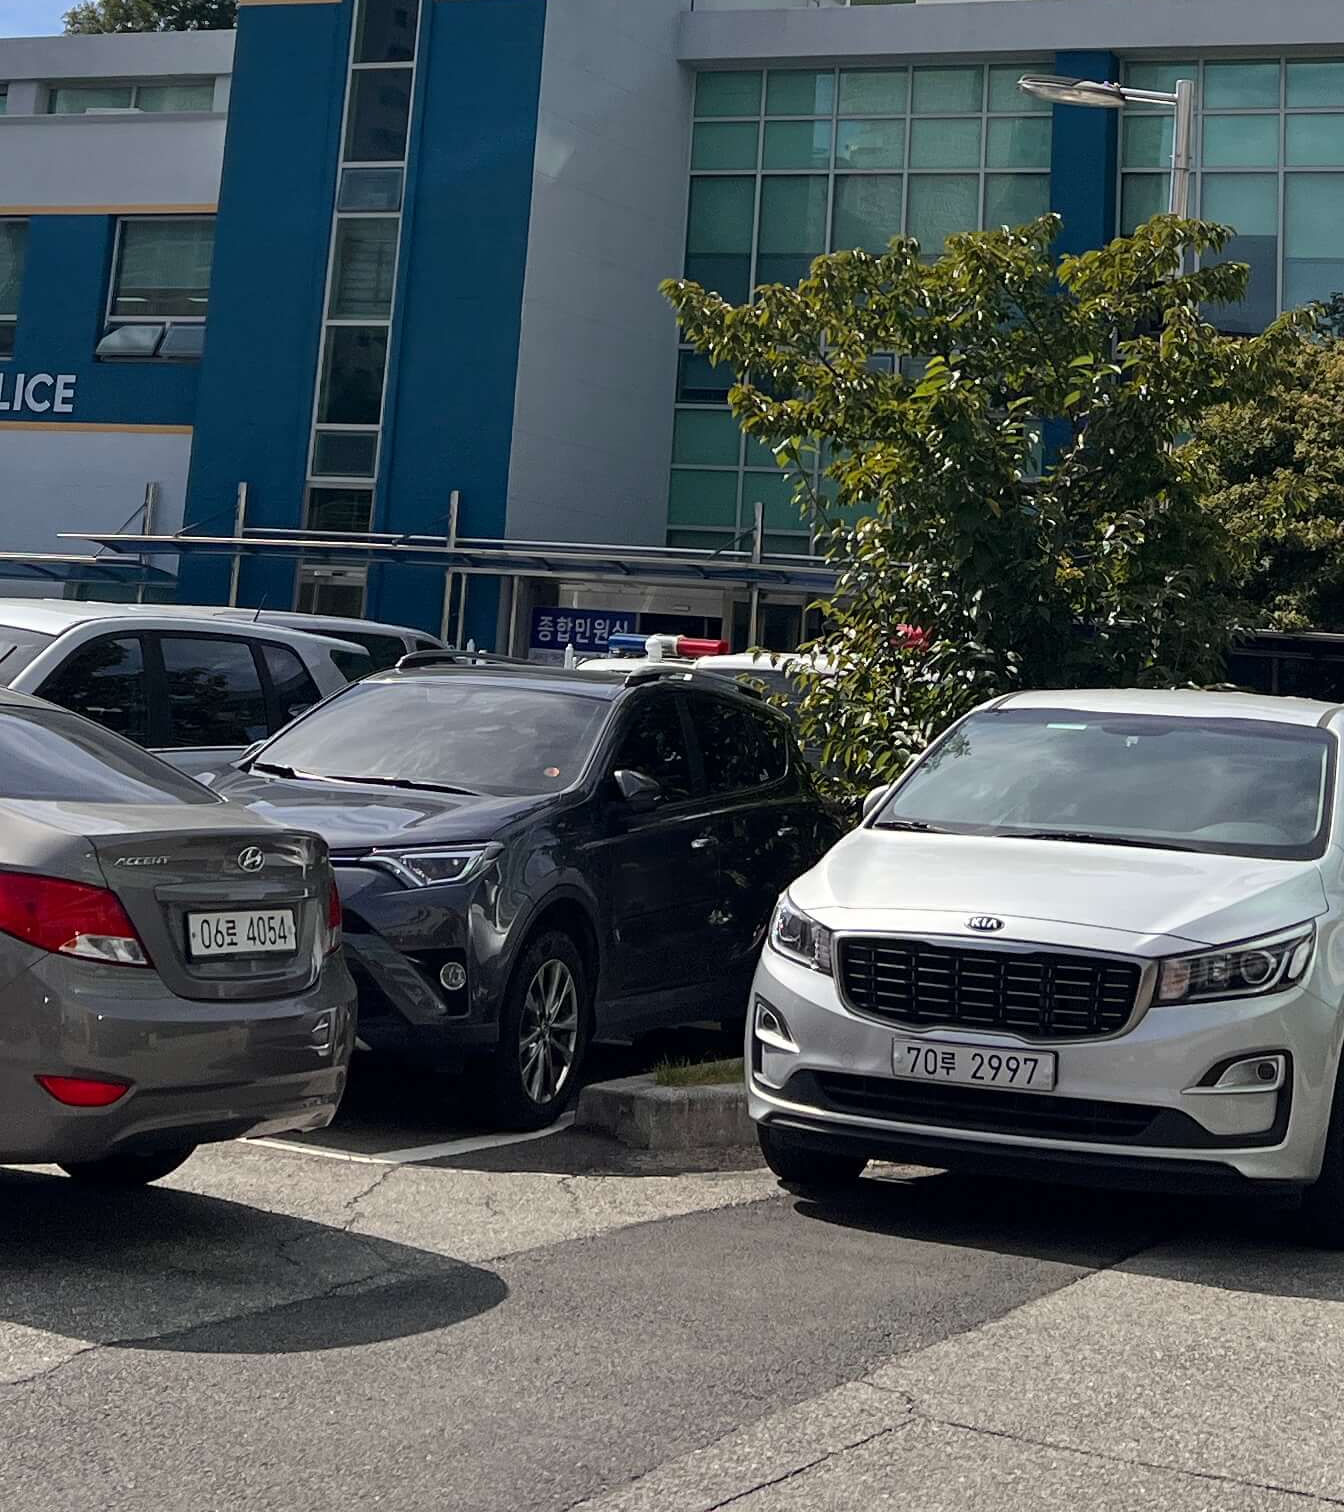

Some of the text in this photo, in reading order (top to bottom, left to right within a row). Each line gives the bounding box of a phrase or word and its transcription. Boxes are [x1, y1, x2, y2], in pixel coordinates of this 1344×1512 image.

[114, 855, 171, 866] ACCENT
[200, 916, 287, 949] 06로 4054
[970, 916, 999, 929] KIA
[907, 1046, 1039, 1084] 70루 2997
